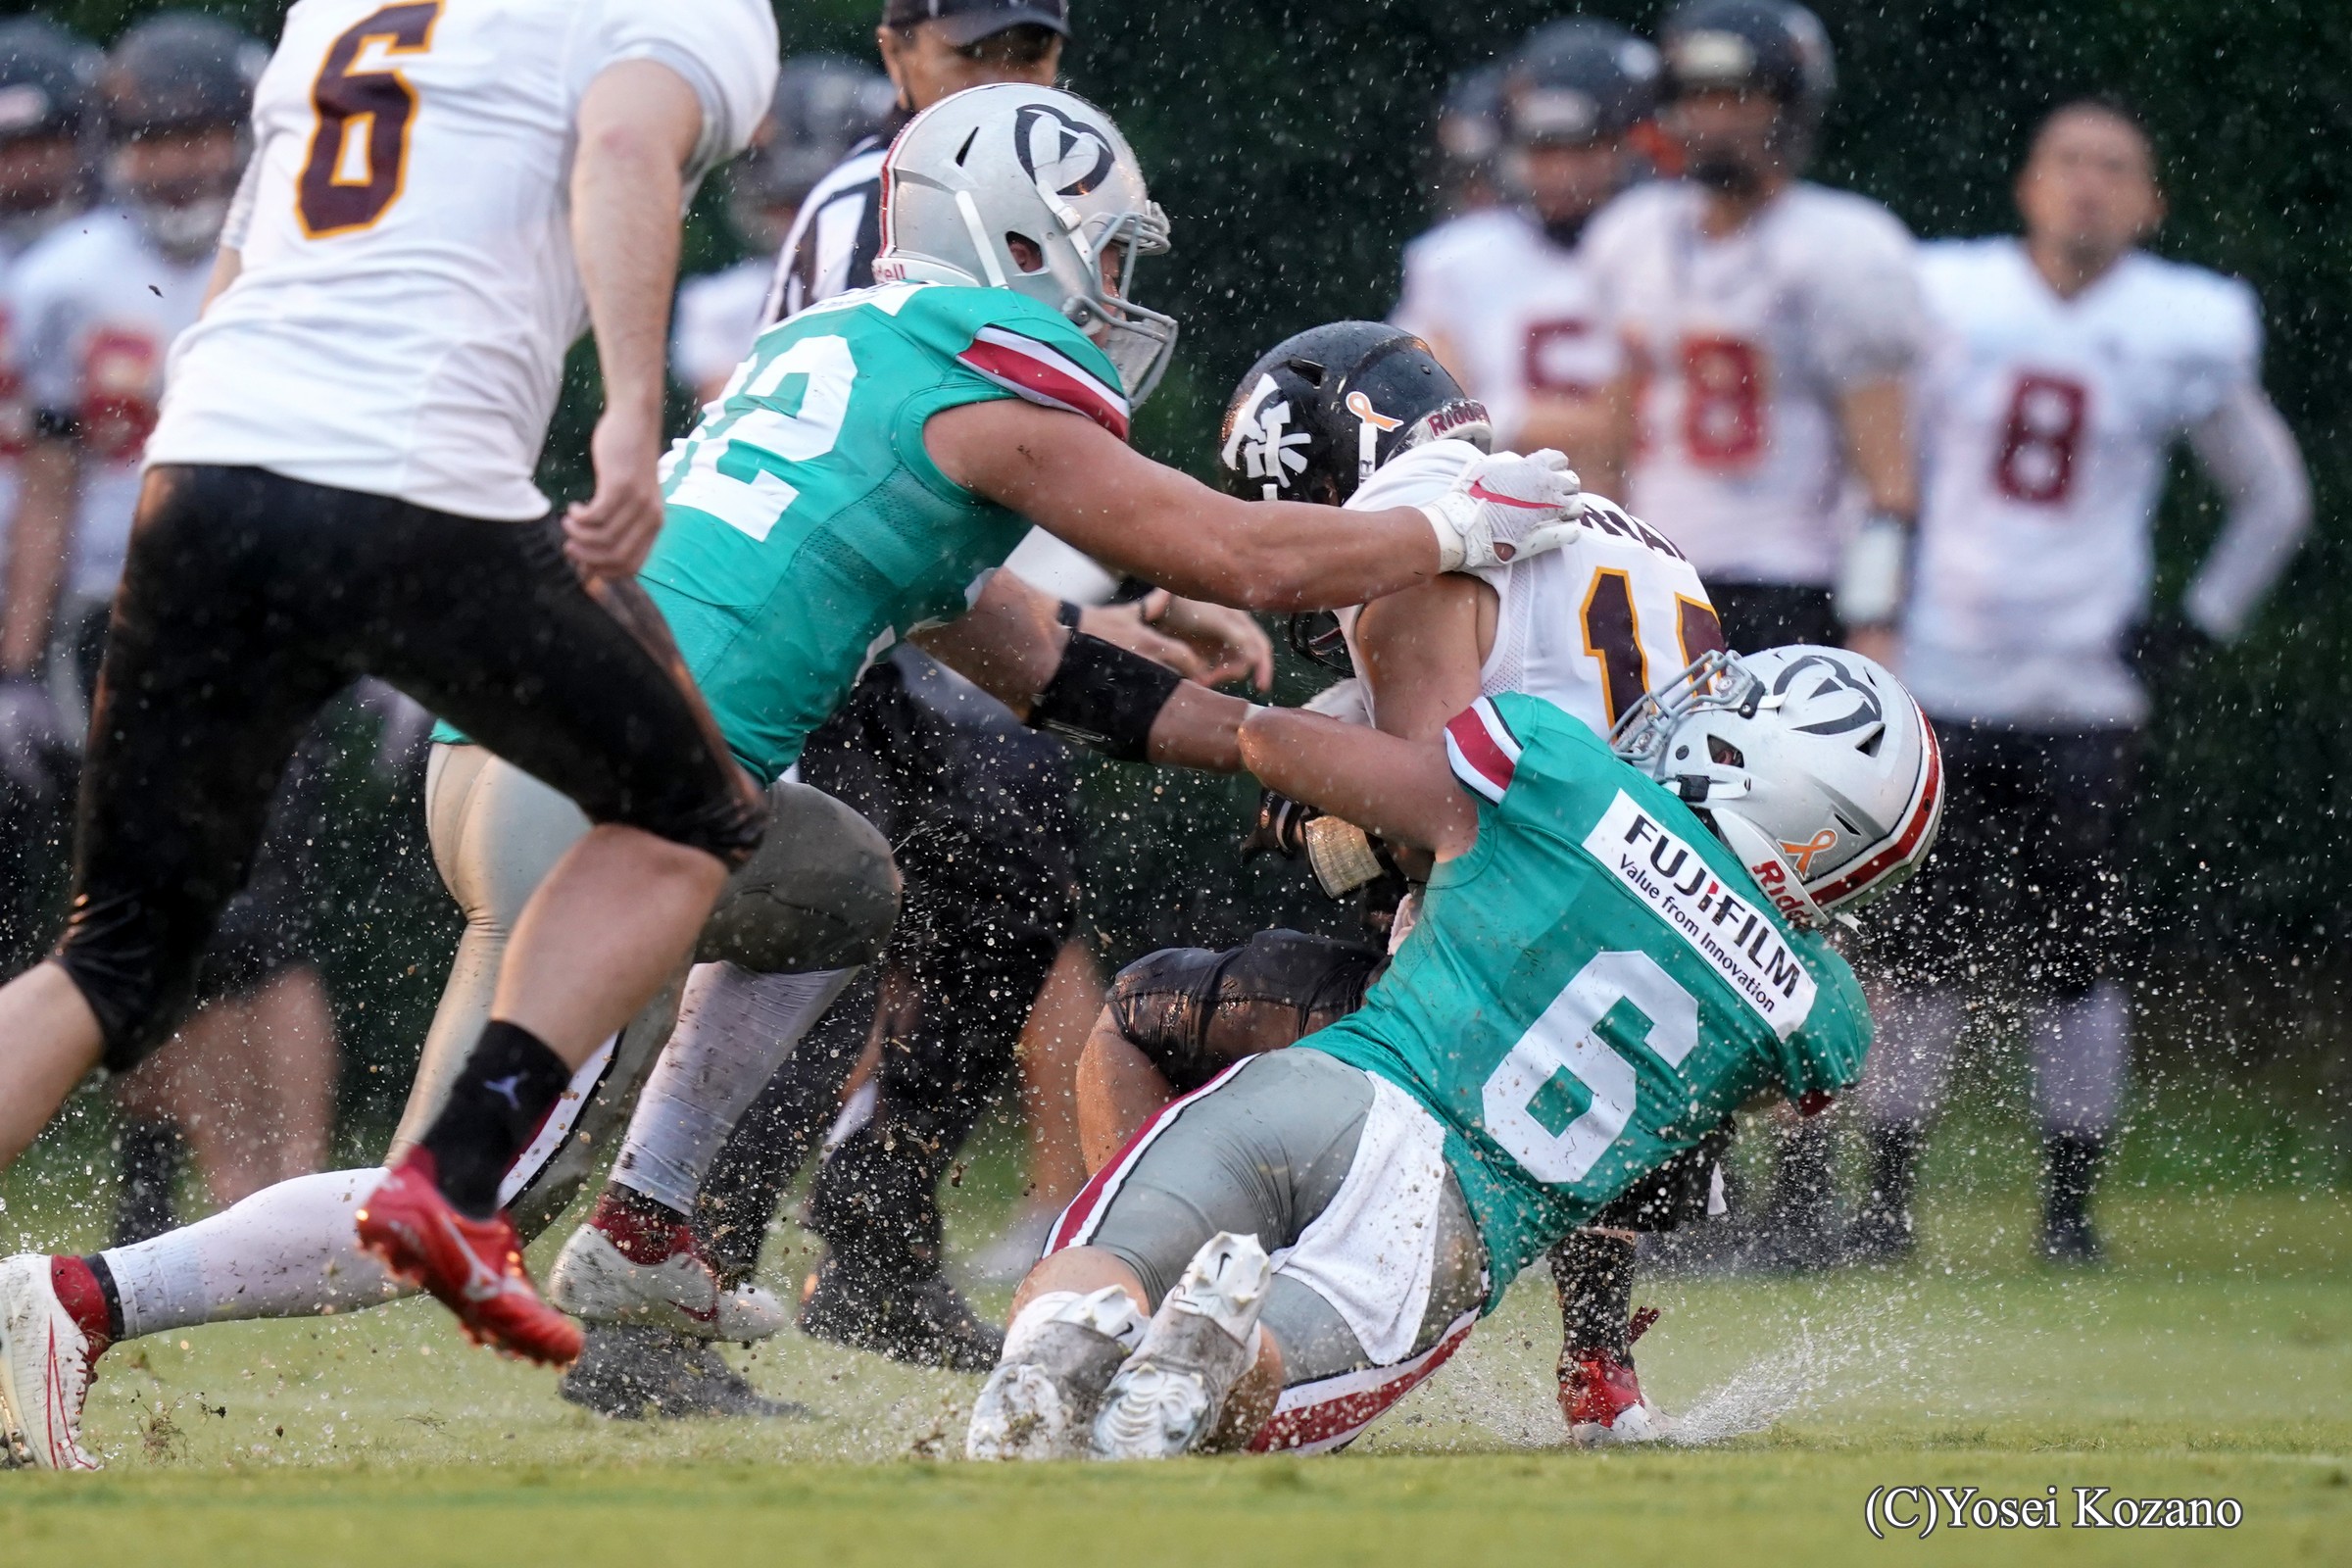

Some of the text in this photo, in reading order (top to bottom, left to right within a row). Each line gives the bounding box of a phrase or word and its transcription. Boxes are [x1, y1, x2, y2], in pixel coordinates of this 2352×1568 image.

[295, 0, 446, 241] 6
[1993, 368, 2087, 509] 8
[1620, 853, 1776, 1013] Value from Innovation
[1623, 813, 1801, 1000] FUJIFILM
[1482, 950, 1699, 1183] 6
